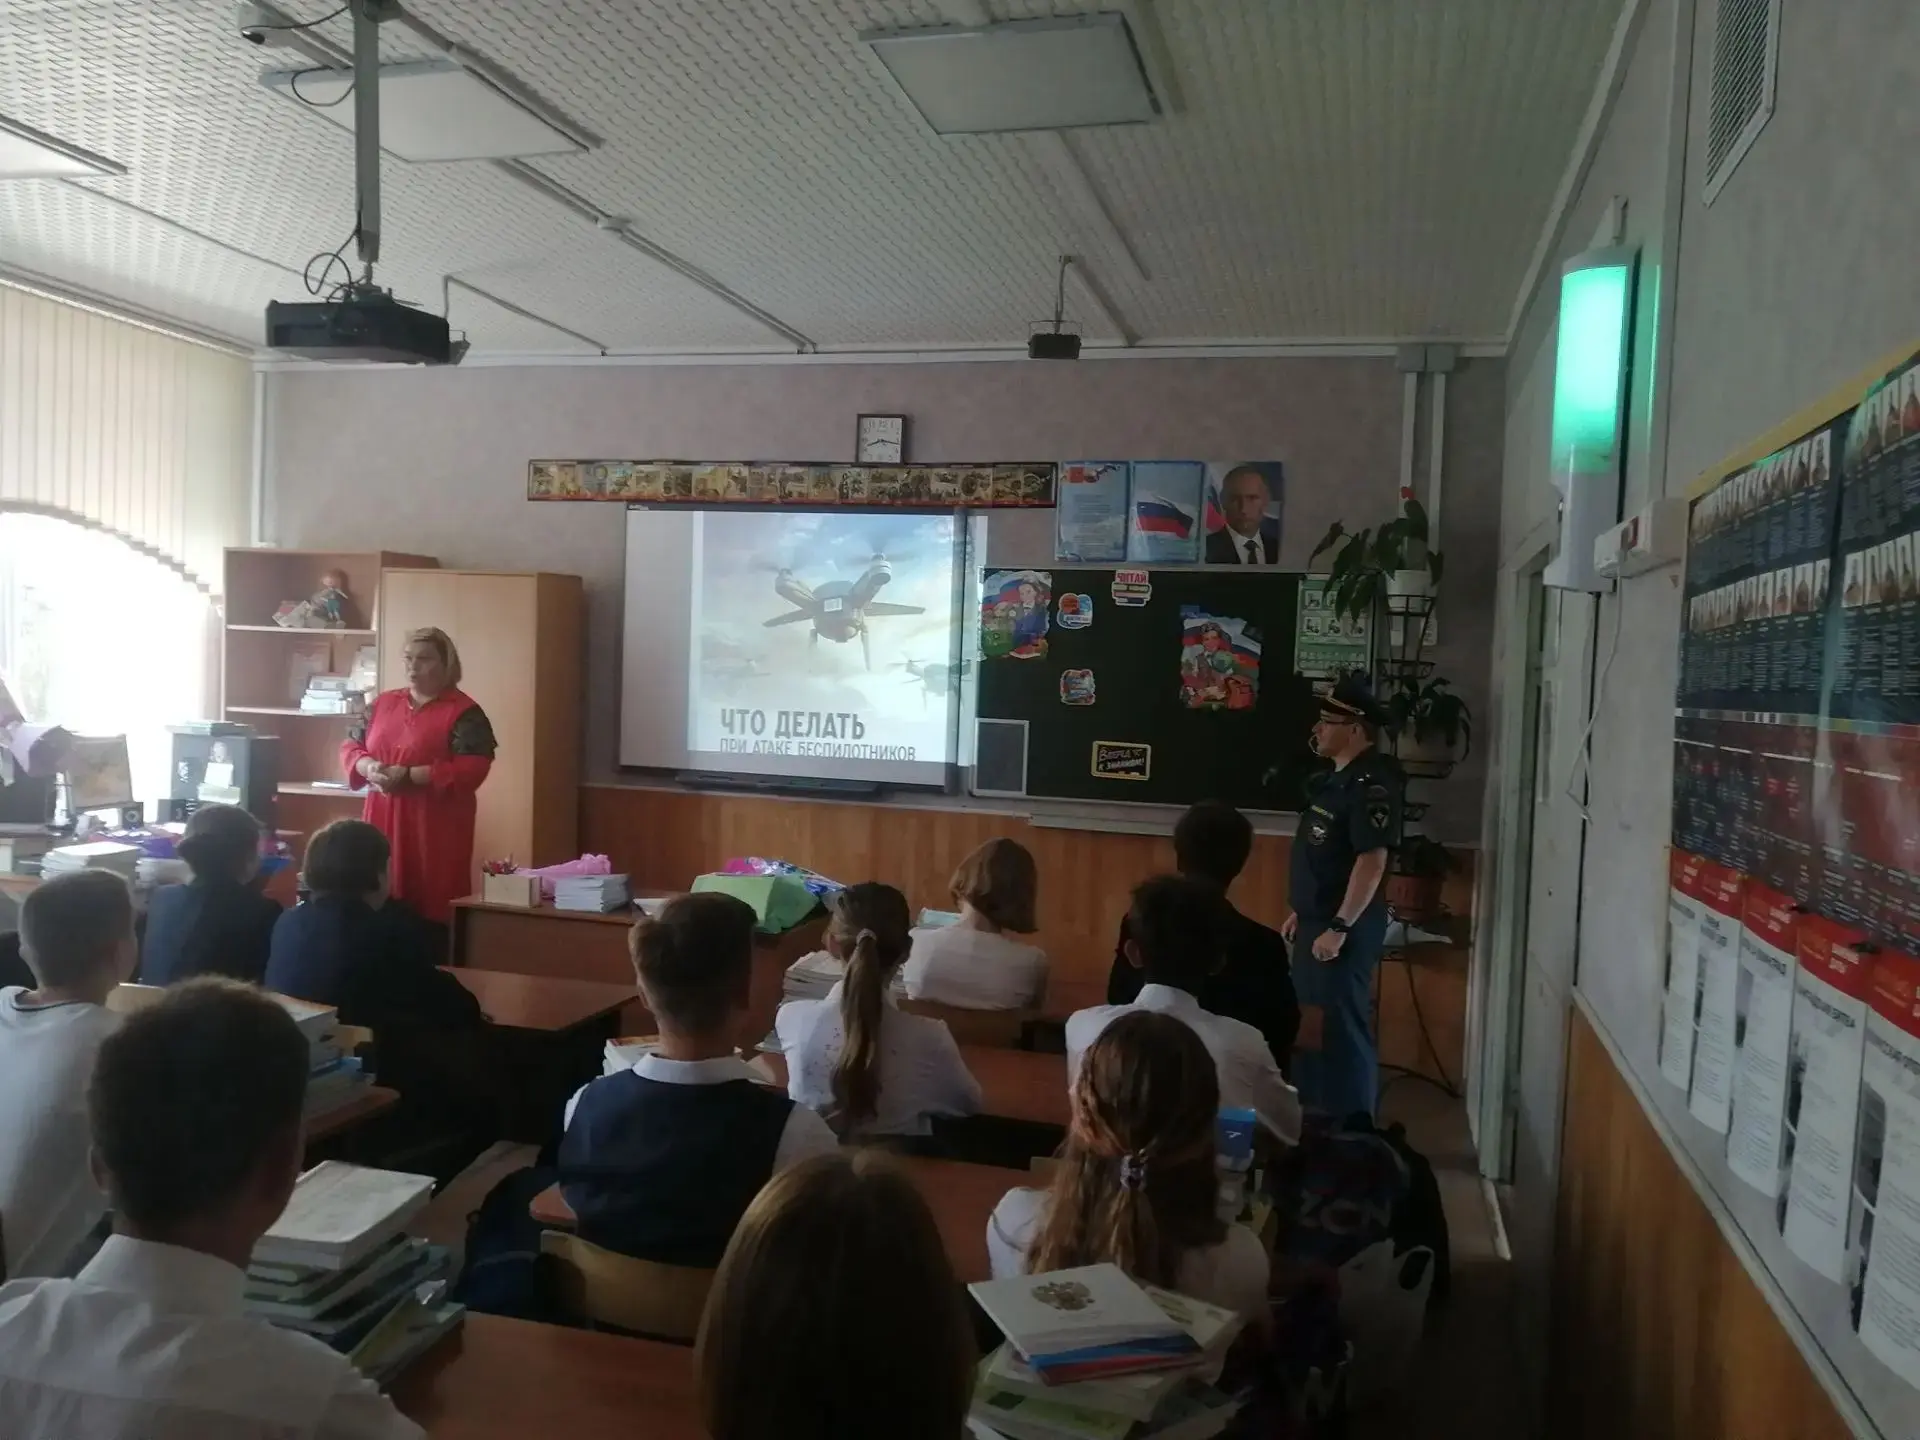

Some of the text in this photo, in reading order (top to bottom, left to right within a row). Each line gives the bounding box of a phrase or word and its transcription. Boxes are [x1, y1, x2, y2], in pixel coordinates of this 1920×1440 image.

[720, 708, 866, 740] ЧТО ДЕЛАТЬ
[721, 738, 916, 761] ПРИ АТАКЕ БЕСПИЛОТНИКОВ
